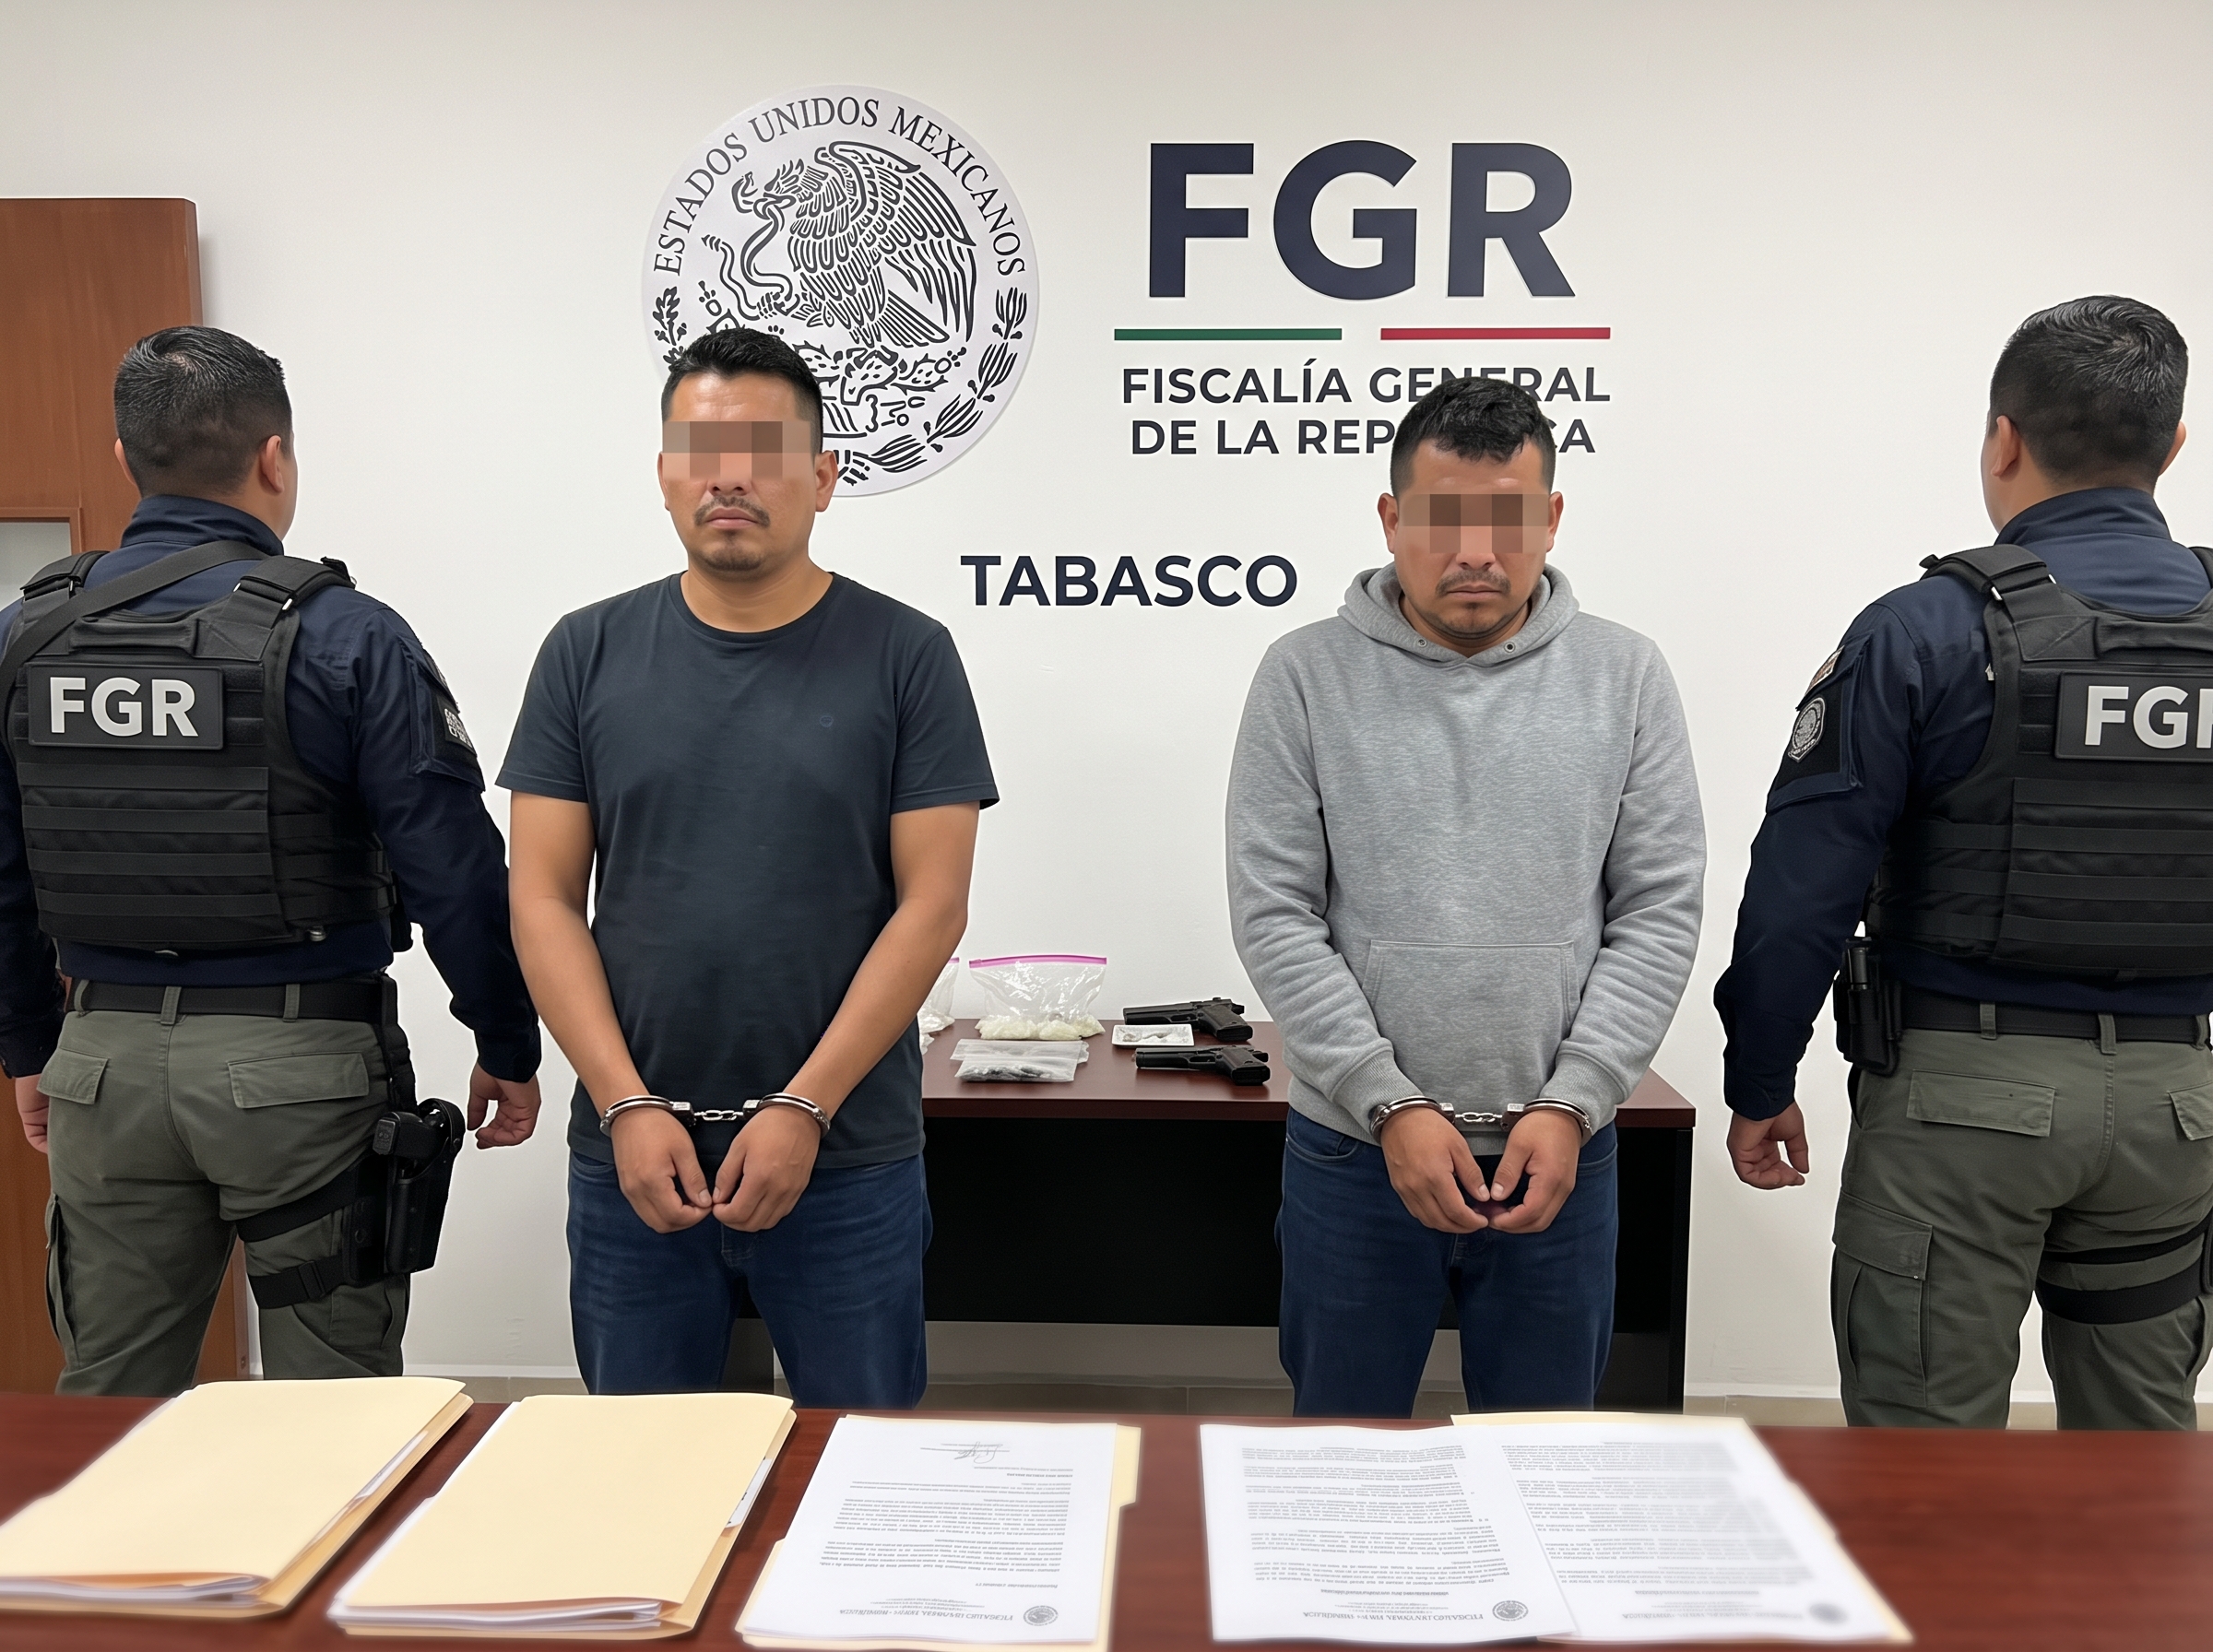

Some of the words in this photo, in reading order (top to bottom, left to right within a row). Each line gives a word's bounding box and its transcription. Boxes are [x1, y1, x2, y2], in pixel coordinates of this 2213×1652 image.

[653, 132, 748, 277] ESTADOS
[748, 96, 880, 143] UNIDOS
[888, 106, 1026, 277] MEXICANOS
[1149, 139, 1576, 301] FGR
[1122, 358, 1352, 404] FISCALÍA
[1369, 367, 1611, 403] GERAL
[1131, 419, 1197, 454] DE
[1217, 419, 1280, 454] LA
[961, 554, 1297, 608] TABASCO
[49, 677, 199, 737] FGR
